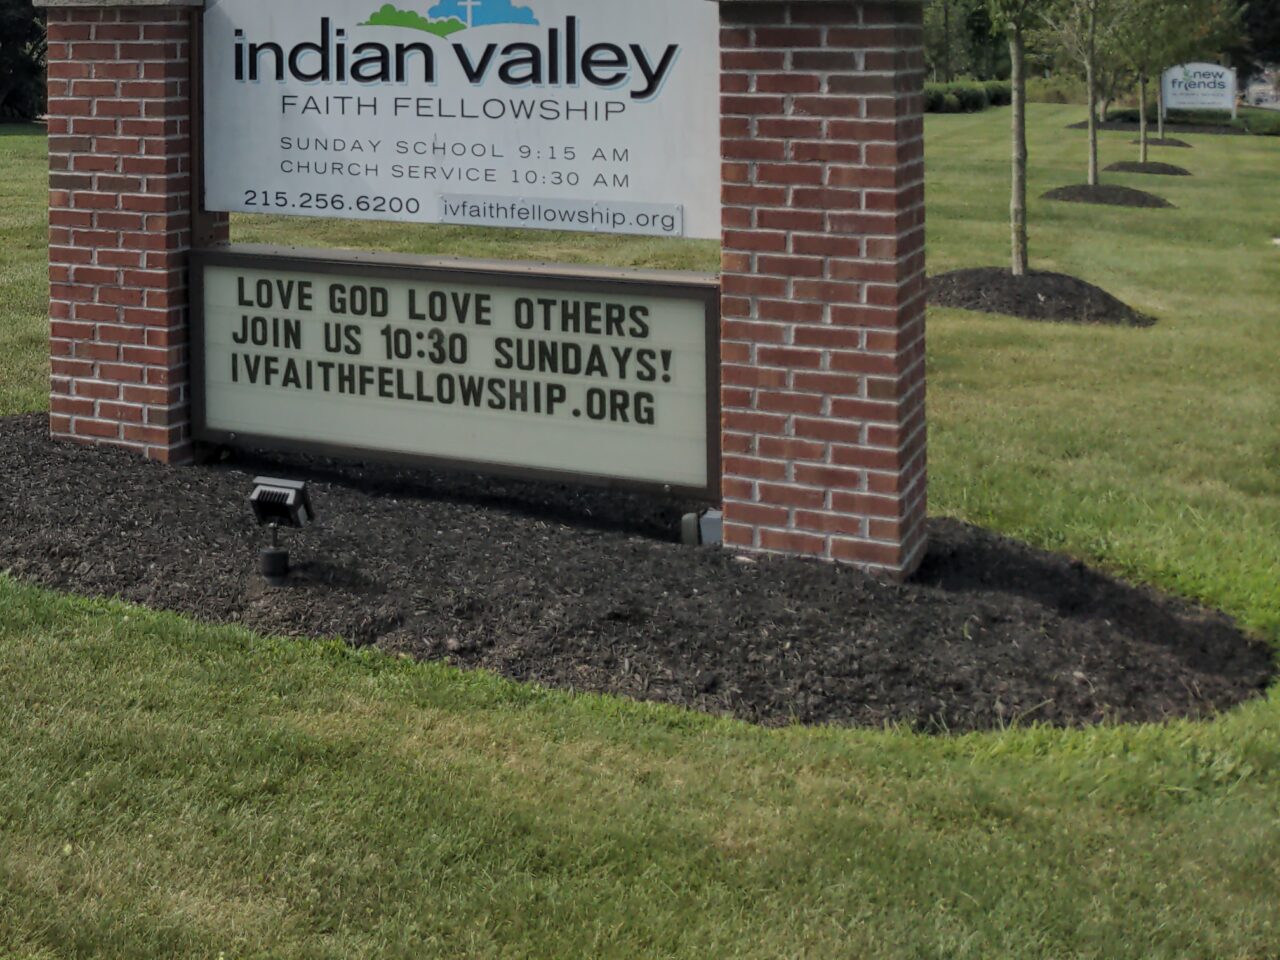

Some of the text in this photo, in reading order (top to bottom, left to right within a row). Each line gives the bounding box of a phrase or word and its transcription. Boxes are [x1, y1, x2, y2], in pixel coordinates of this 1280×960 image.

[233, 15, 680, 99] indian valley
[1193, 71, 1224, 79] new
[281, 94, 627, 121] FAITH FELLOWSHIP
[279, 137, 630, 162] SUNDAY SCHOOL 9:15 AM
[279, 160, 630, 188] CHURCH SERVICE 10:30 AM
[244, 189, 676, 232] 215.256.6200 ivfaithfellowship.org
[237, 276, 649, 339] LOVE GOD LOVE OTHERS
[232, 316, 672, 383] JOIN US 10:30 SUNDAYS!
[231, 353, 655, 425] IVFAITHFELLOWSHIP.ORG
